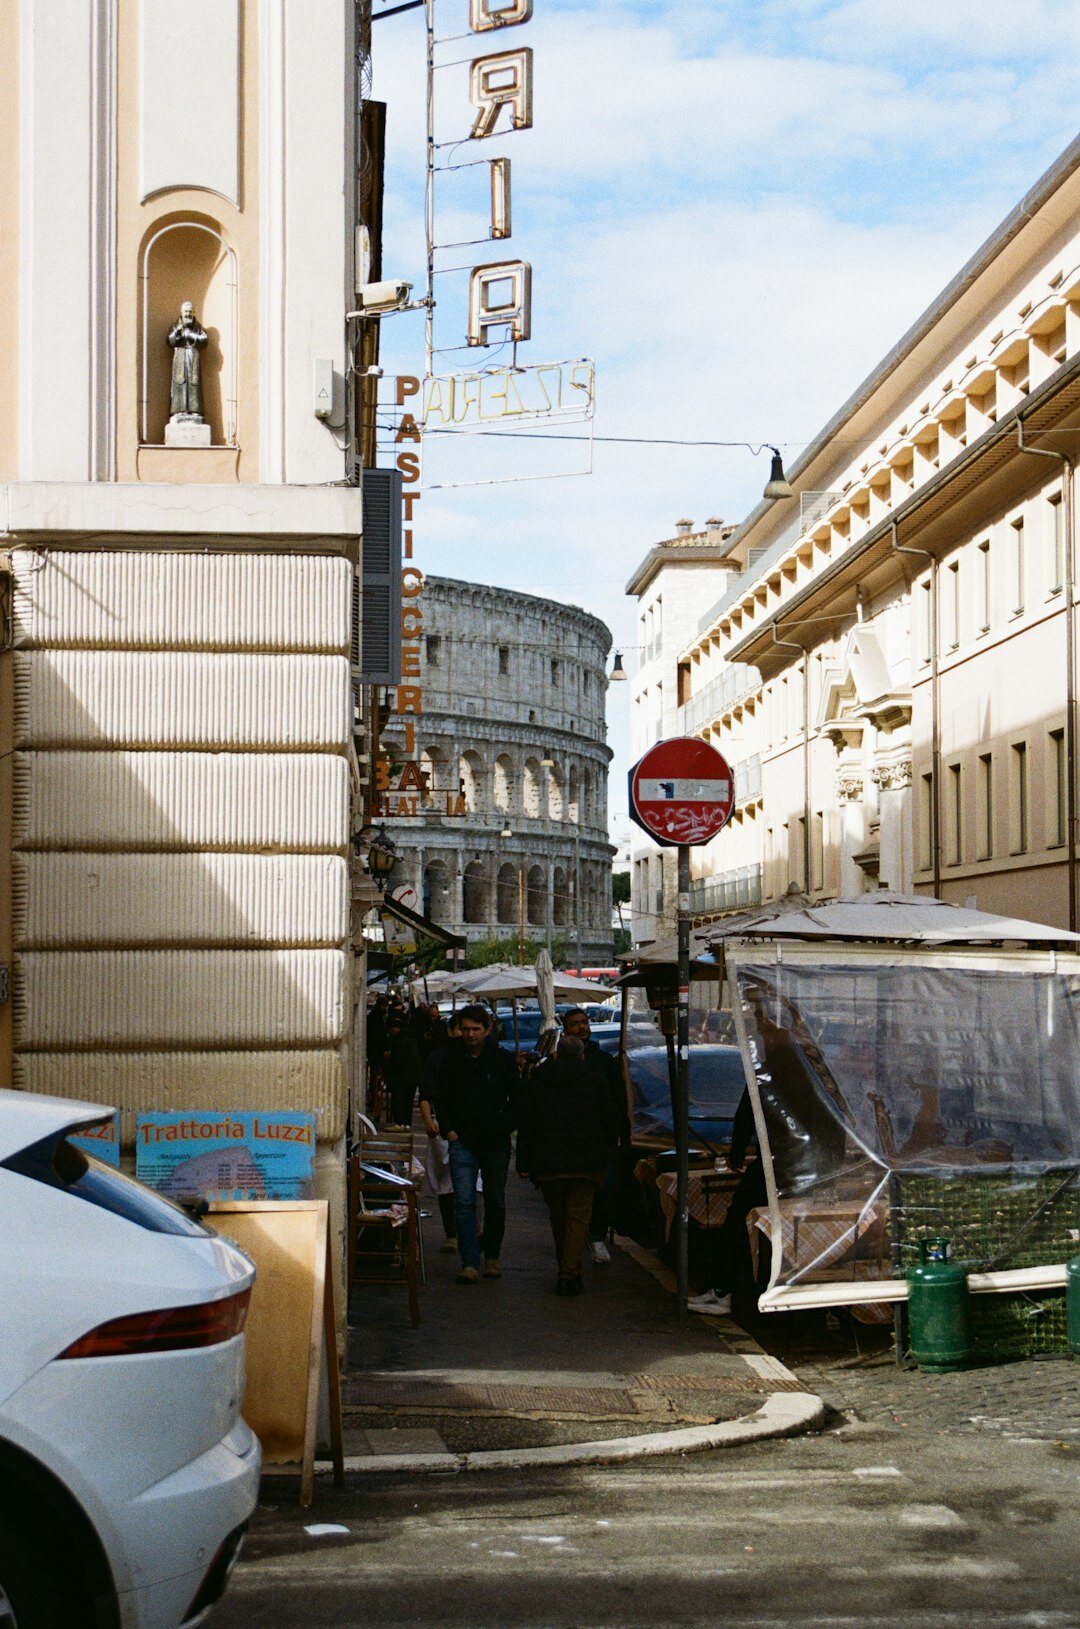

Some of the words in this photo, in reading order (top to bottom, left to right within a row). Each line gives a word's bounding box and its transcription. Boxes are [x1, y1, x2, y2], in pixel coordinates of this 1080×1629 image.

[76, 1122, 115, 1143] zzi
[141, 1118, 244, 1145] Trattoria
[254, 1119, 311, 1145] Luzzi
